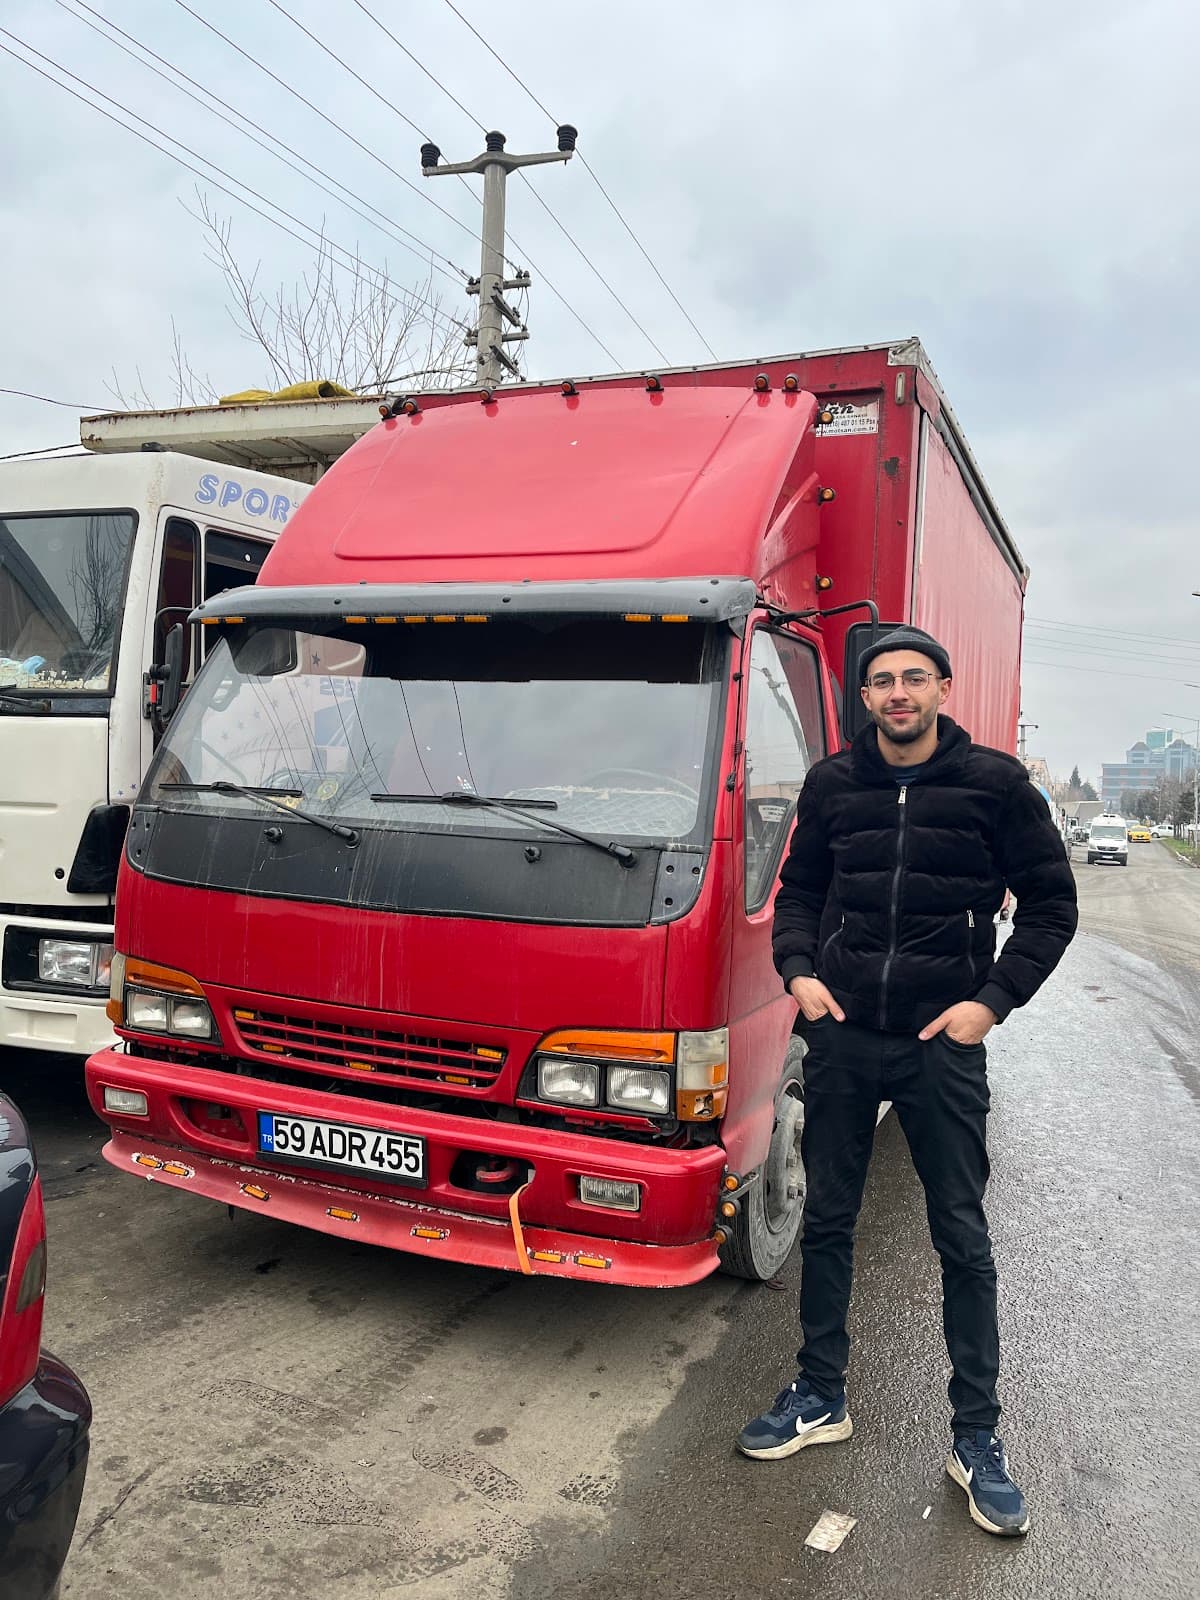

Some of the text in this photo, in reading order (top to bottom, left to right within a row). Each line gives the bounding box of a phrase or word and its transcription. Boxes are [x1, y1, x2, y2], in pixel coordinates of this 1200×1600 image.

[195, 474, 298, 523] SPOR
[262, 1134, 273, 1144] TR
[274, 1119, 420, 1173] 59 ADR 455
